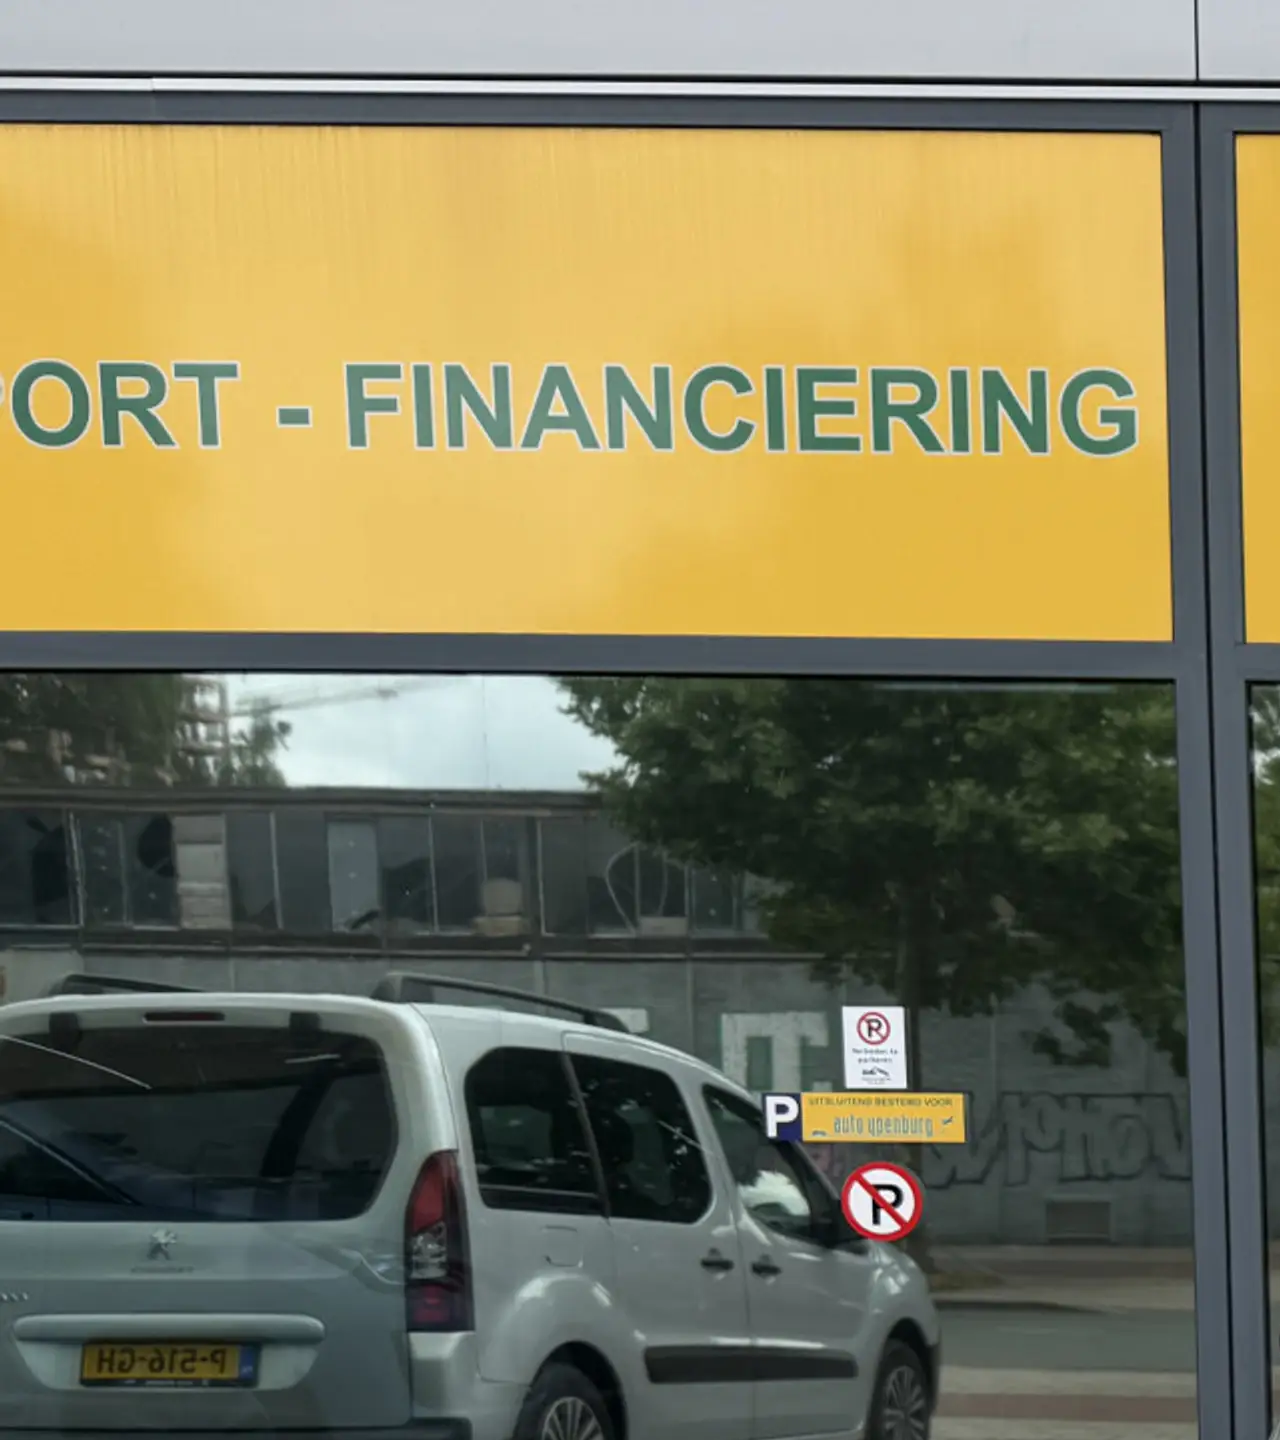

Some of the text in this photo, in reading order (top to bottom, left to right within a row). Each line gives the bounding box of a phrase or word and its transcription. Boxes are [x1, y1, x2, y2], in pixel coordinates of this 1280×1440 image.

[0, 358, 241, 450] ORT
[343, 362, 1138, 457] FINANCIERING
[924, 1096, 953, 1107] VOOR
[833, 1114, 864, 1134] auto
